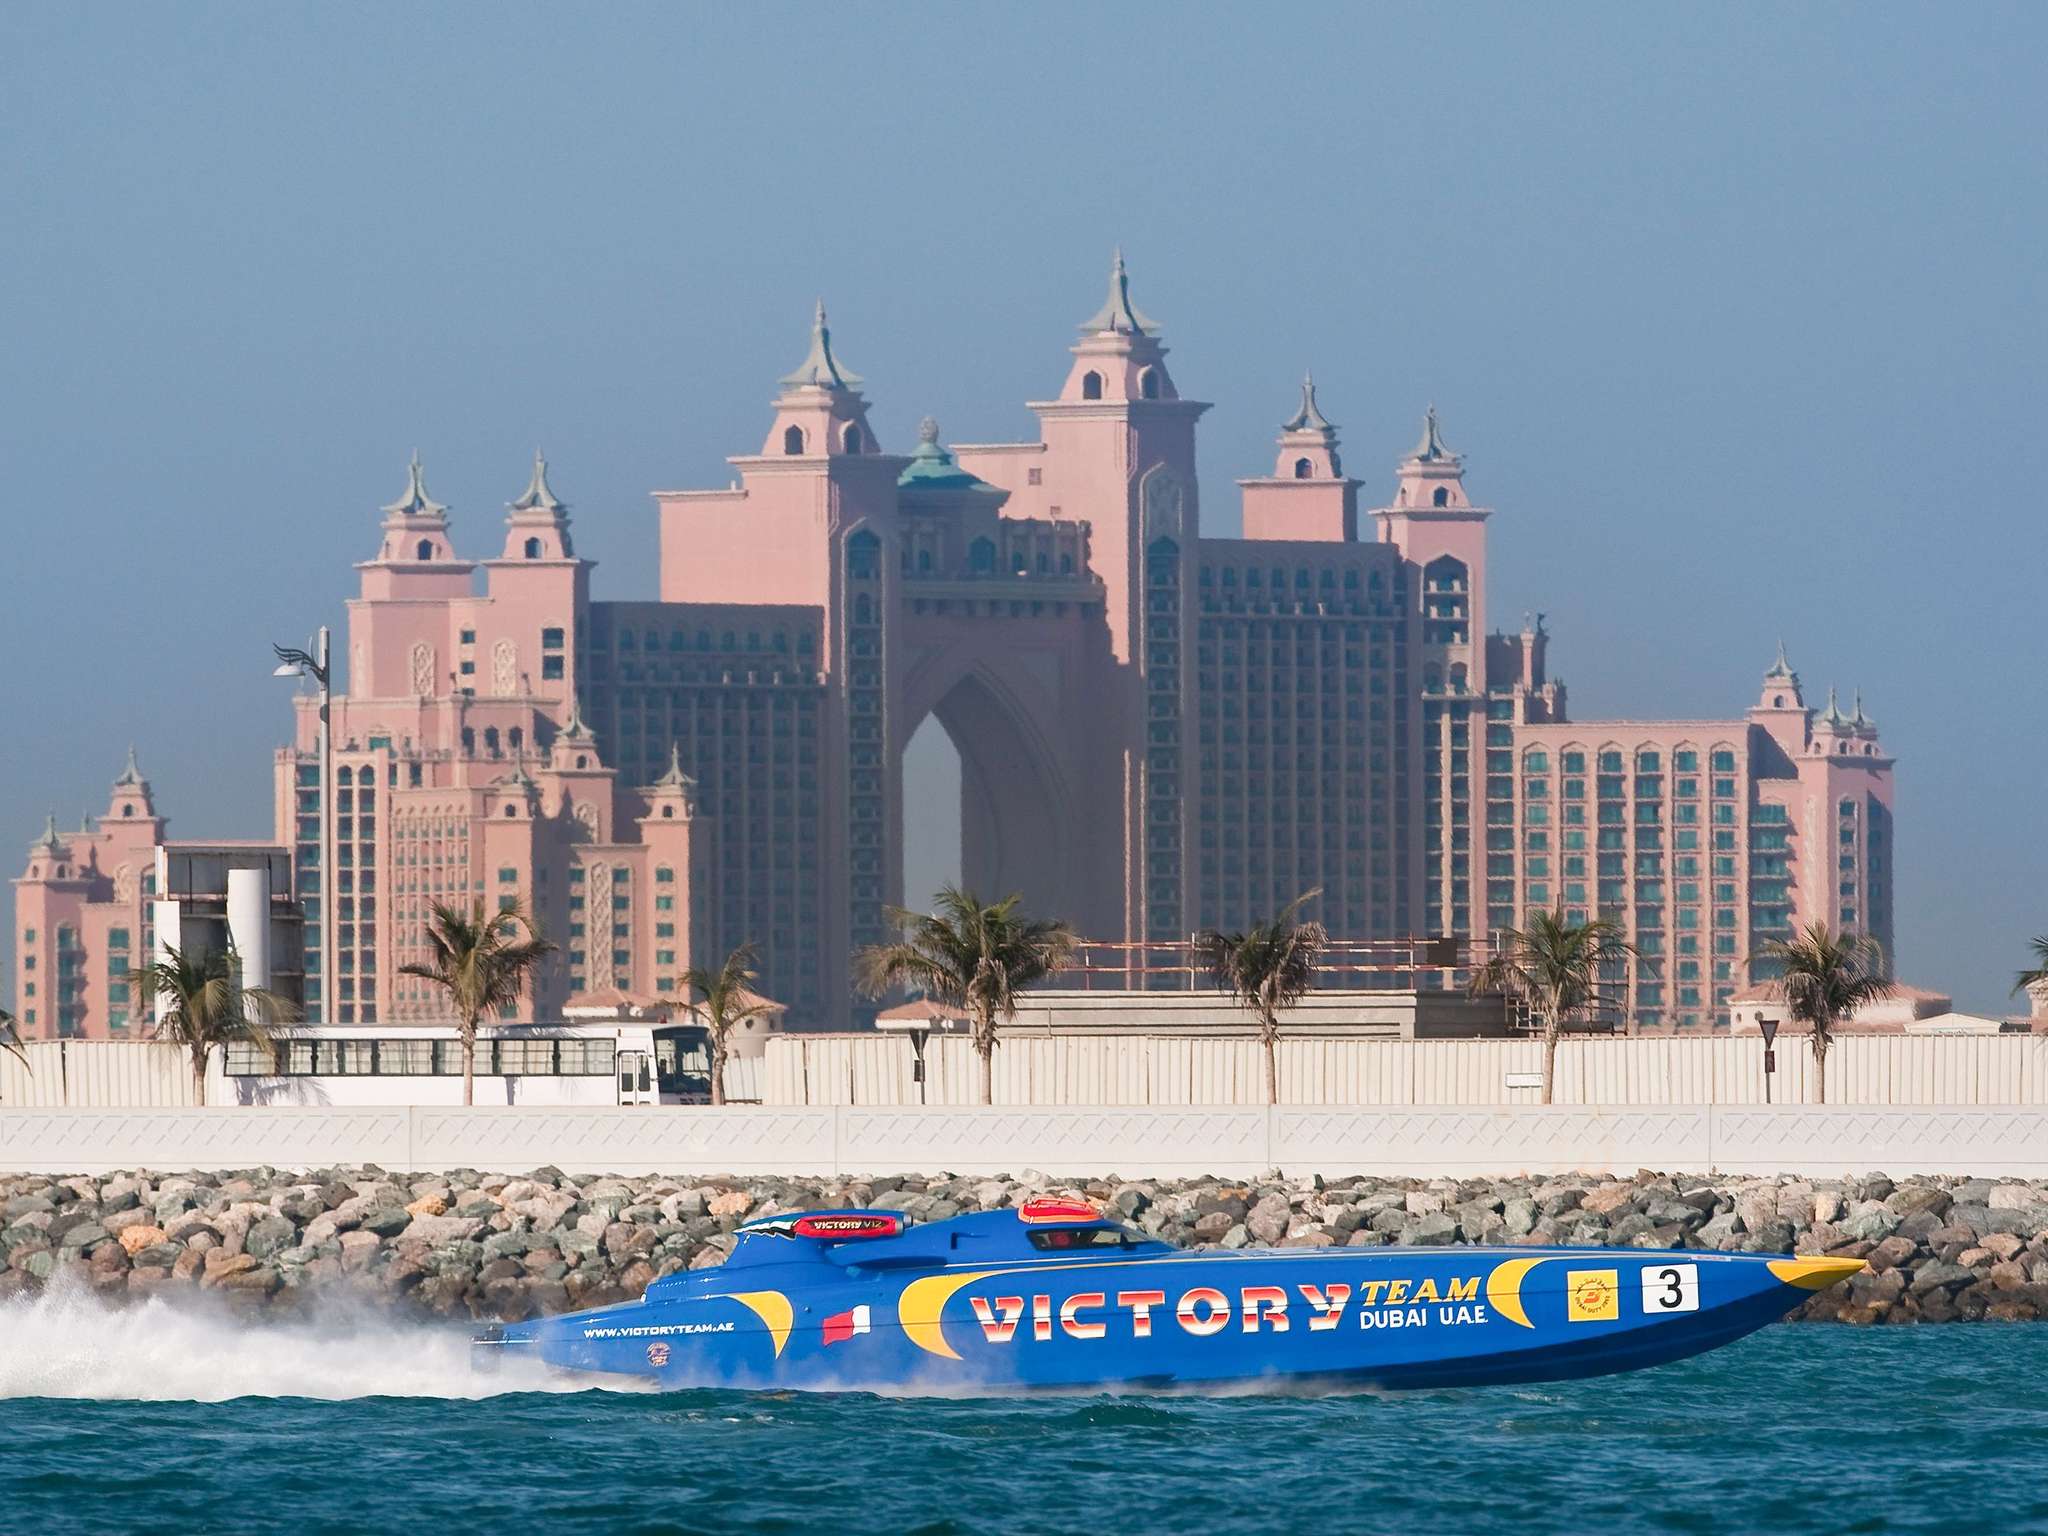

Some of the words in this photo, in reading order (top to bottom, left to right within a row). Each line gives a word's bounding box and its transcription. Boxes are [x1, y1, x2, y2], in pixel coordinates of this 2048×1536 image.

[814, 1221, 862, 1229] VICTORY
[1359, 1277, 1482, 1304] TEAM
[1659, 1268, 1683, 1308] 3
[969, 1284, 1351, 1344] VICTORY
[1359, 1305, 1427, 1330] DUBAI
[1438, 1303, 1489, 1326] U.A.E.
[583, 1322, 735, 1339] WWW.VICTORYTEAM.AE
